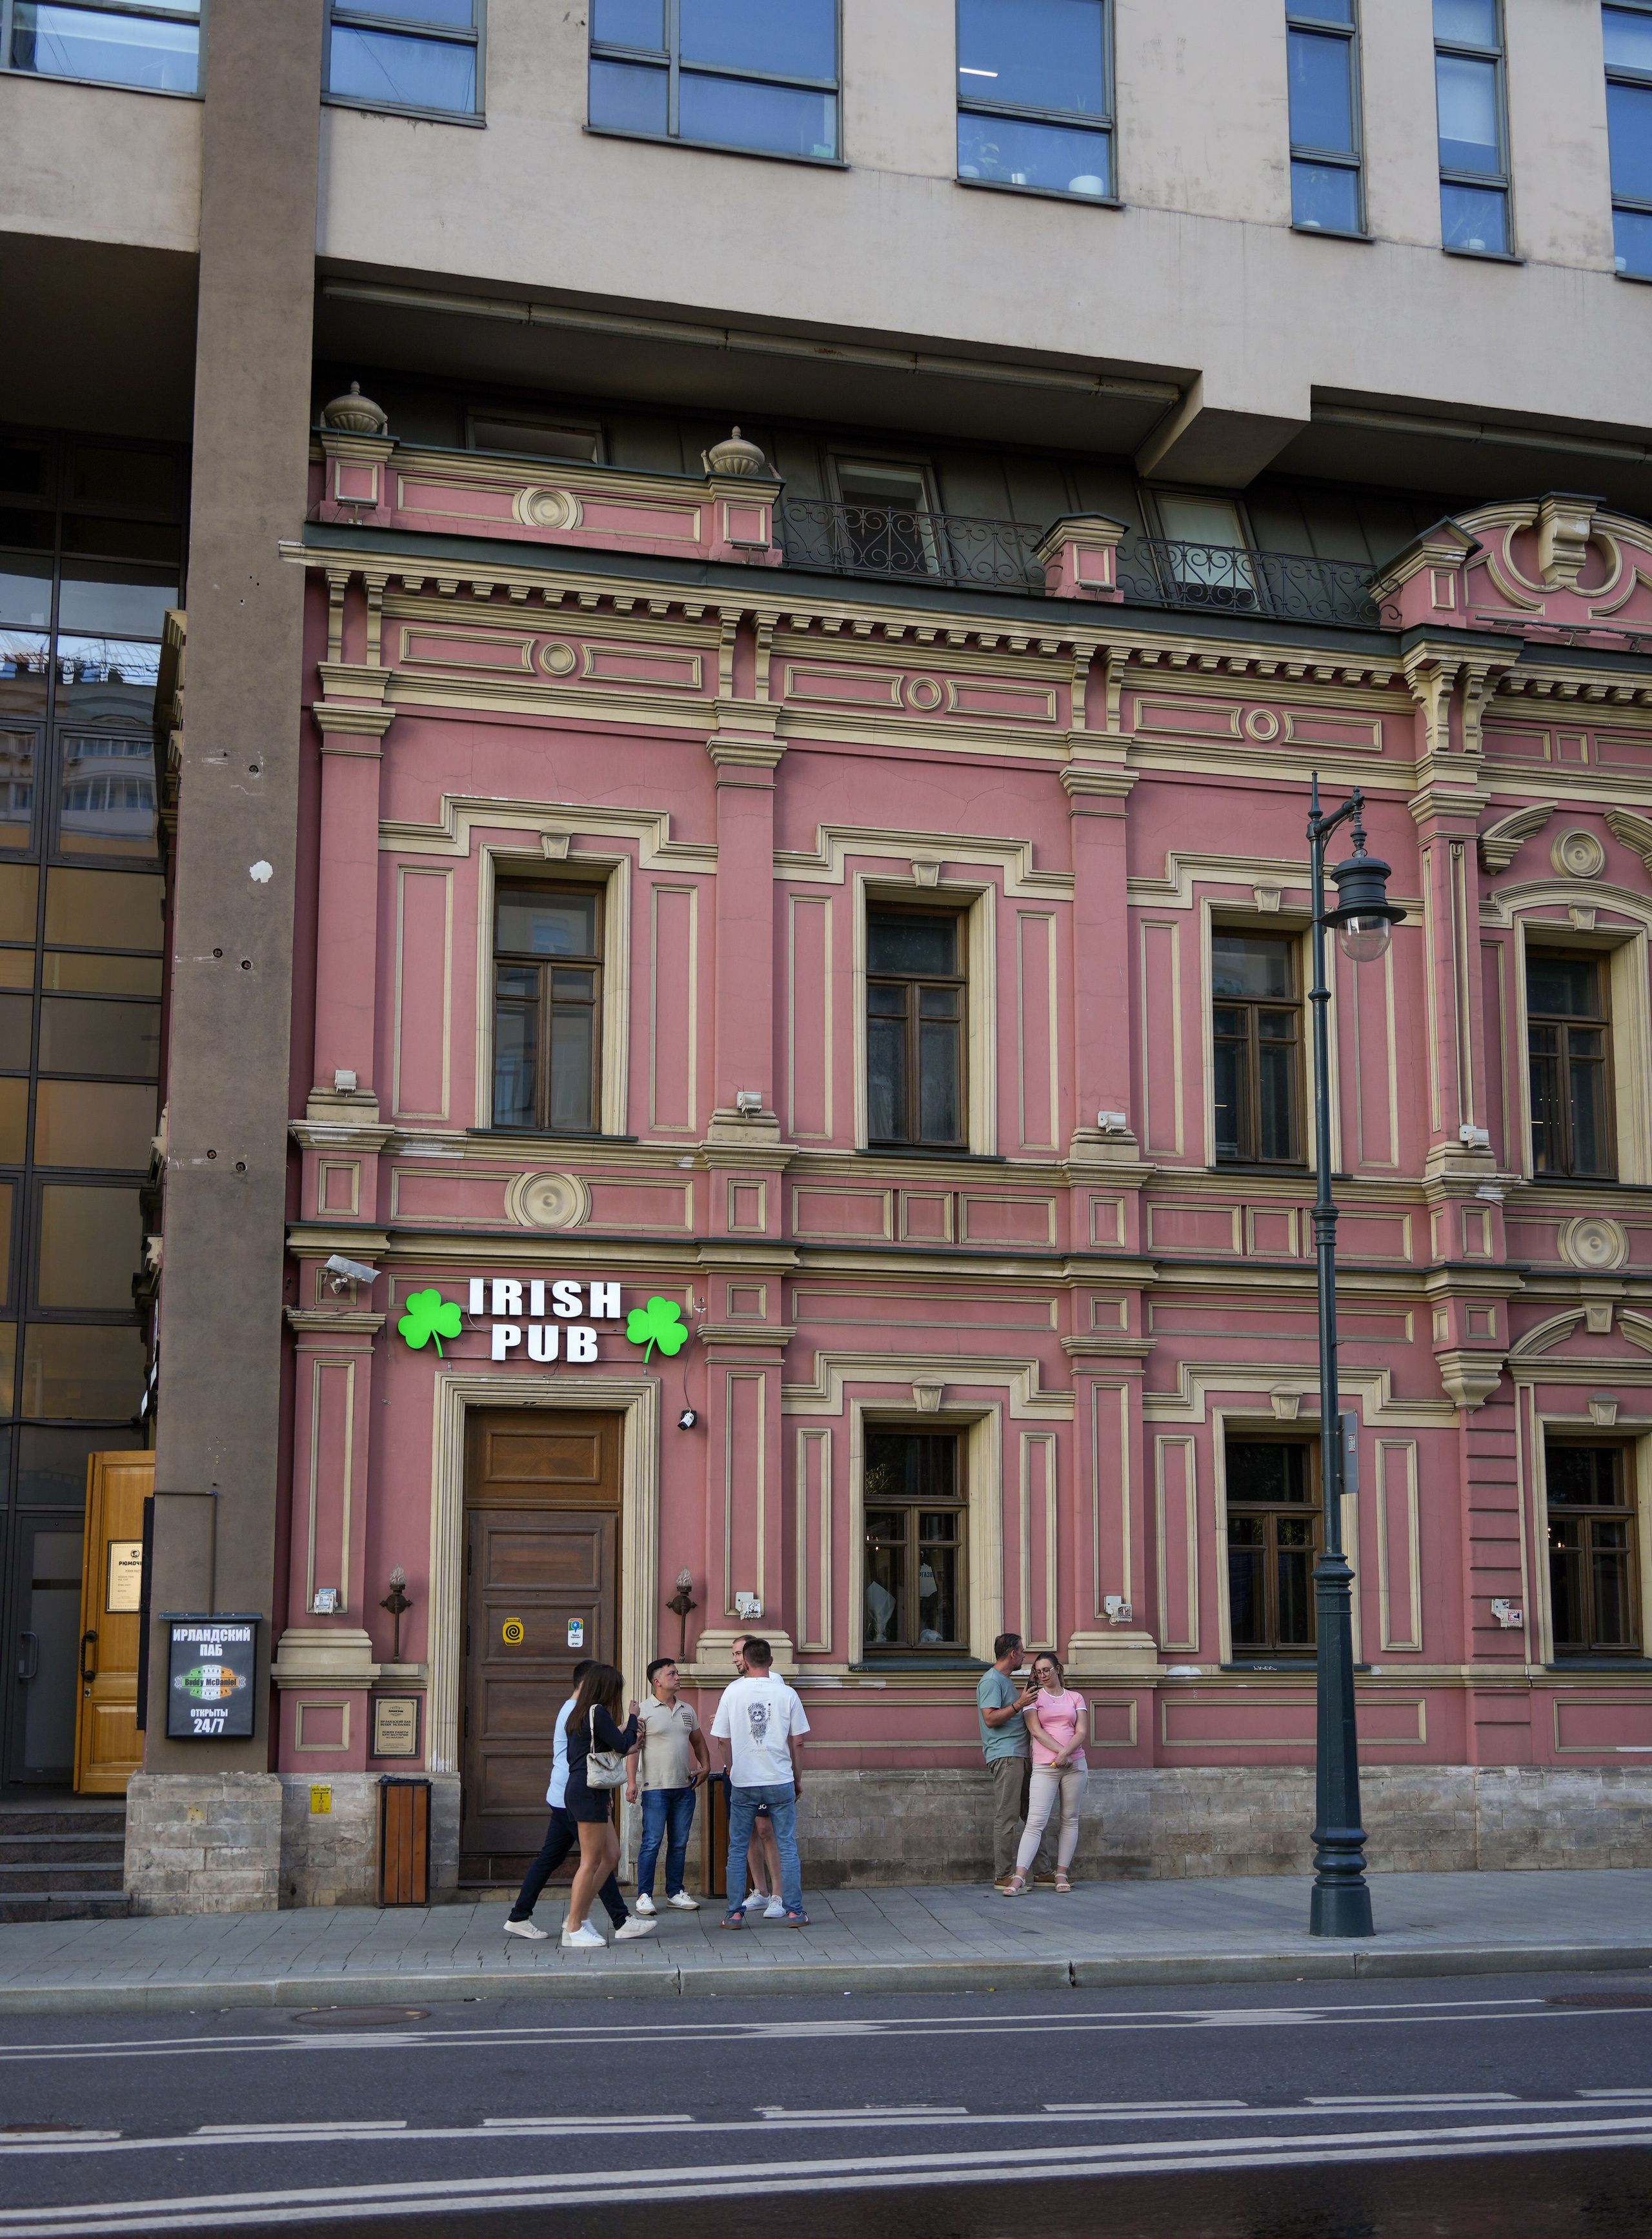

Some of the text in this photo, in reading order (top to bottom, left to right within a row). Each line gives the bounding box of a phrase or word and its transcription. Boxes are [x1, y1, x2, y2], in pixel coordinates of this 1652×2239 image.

[468, 1278, 621, 1318] IRISH
[491, 1323, 598, 1363] PUB
[173, 1627, 250, 1643] ИРЛАНДСКИЙ
[199, 1644, 223, 1656] ПАБ
[190, 1709, 228, 1717] ОТКРЫТЫ
[194, 1718, 224, 1733] 24/7
